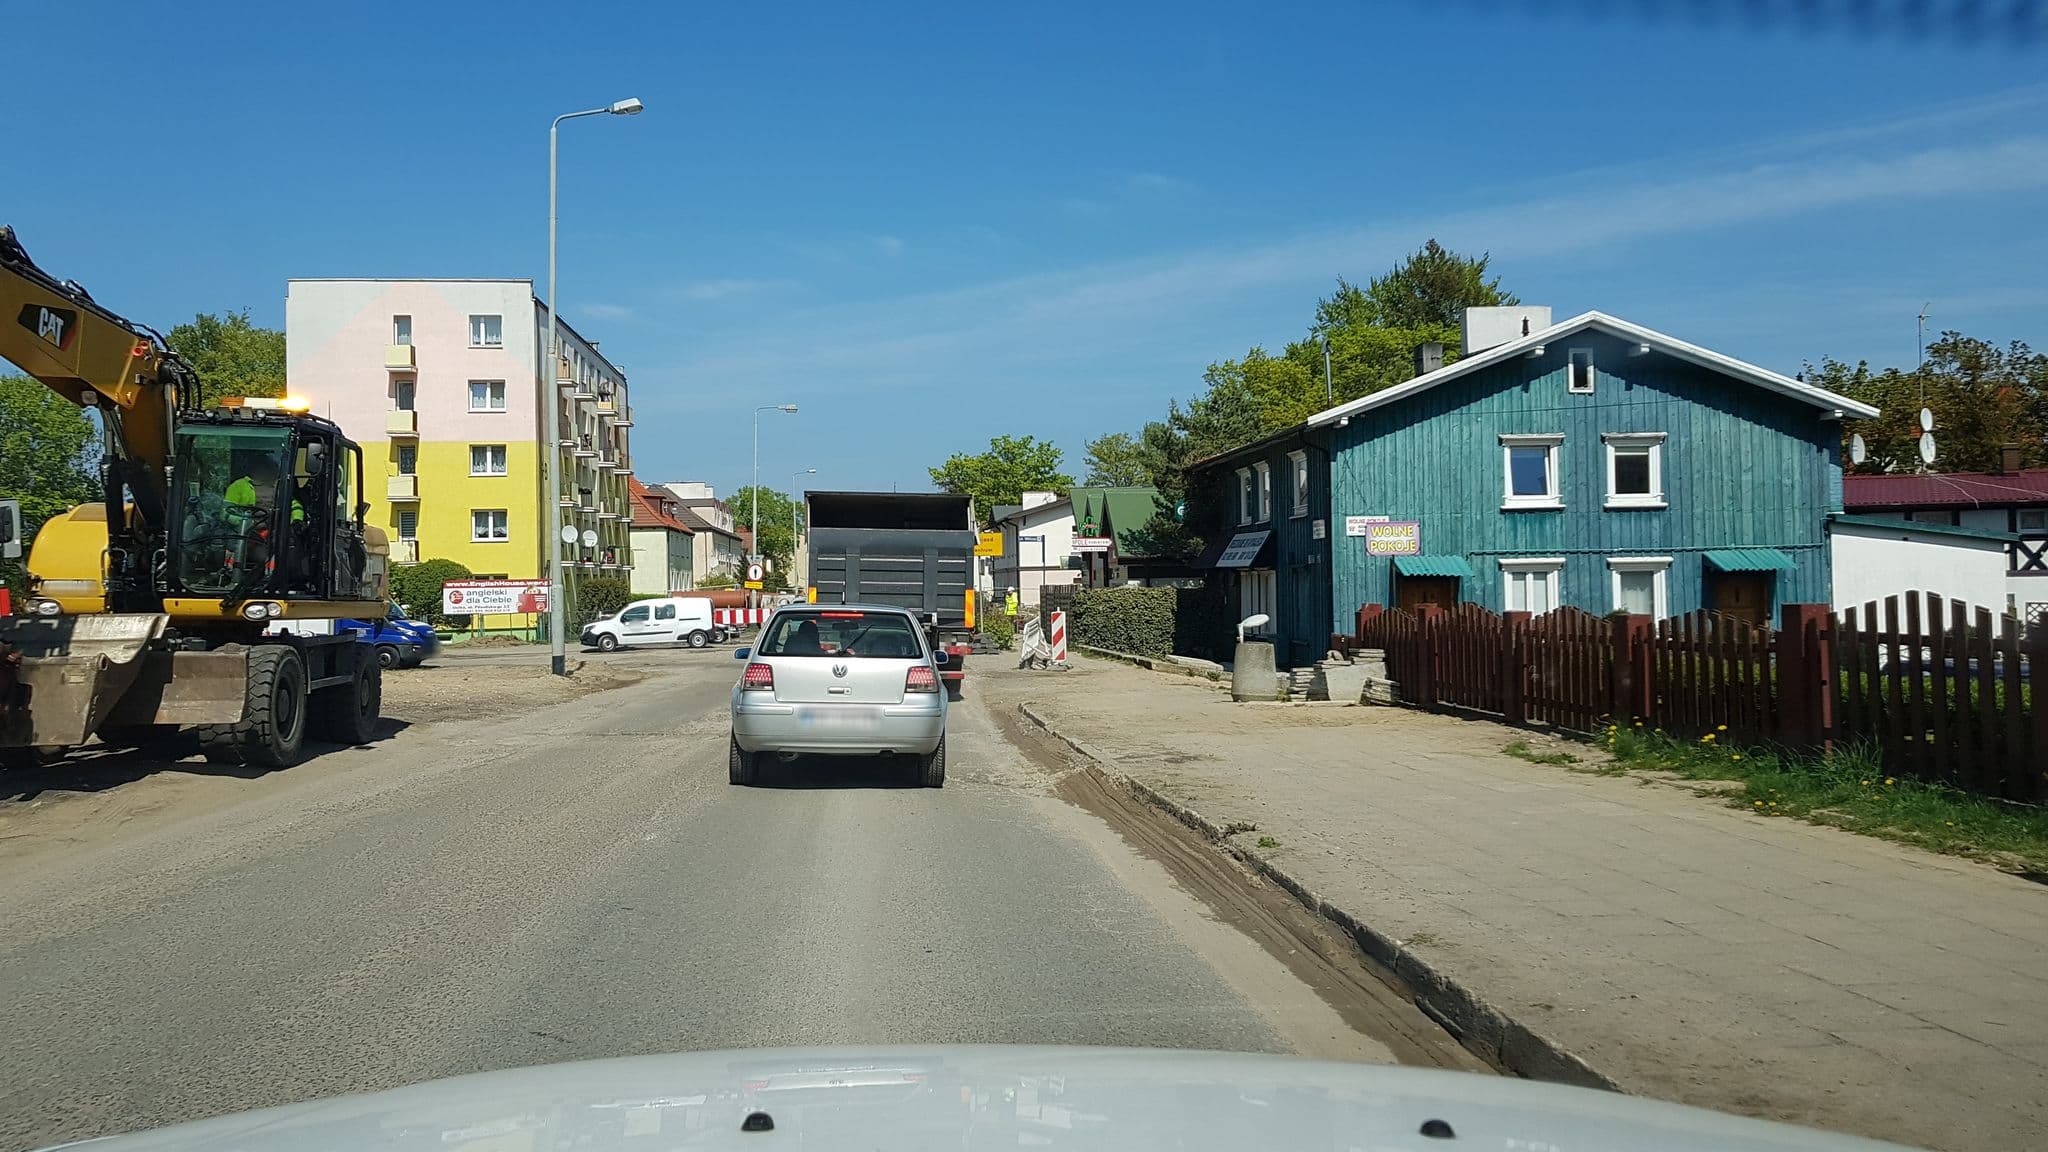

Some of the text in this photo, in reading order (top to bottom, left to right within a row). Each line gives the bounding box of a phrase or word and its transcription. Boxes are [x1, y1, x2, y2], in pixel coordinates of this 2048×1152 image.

[39, 307, 64, 347] CAT
[1371, 525, 1414, 537] WOLNE
[1369, 540, 1417, 552] POKOJE
[466, 589, 508, 597] angielski
